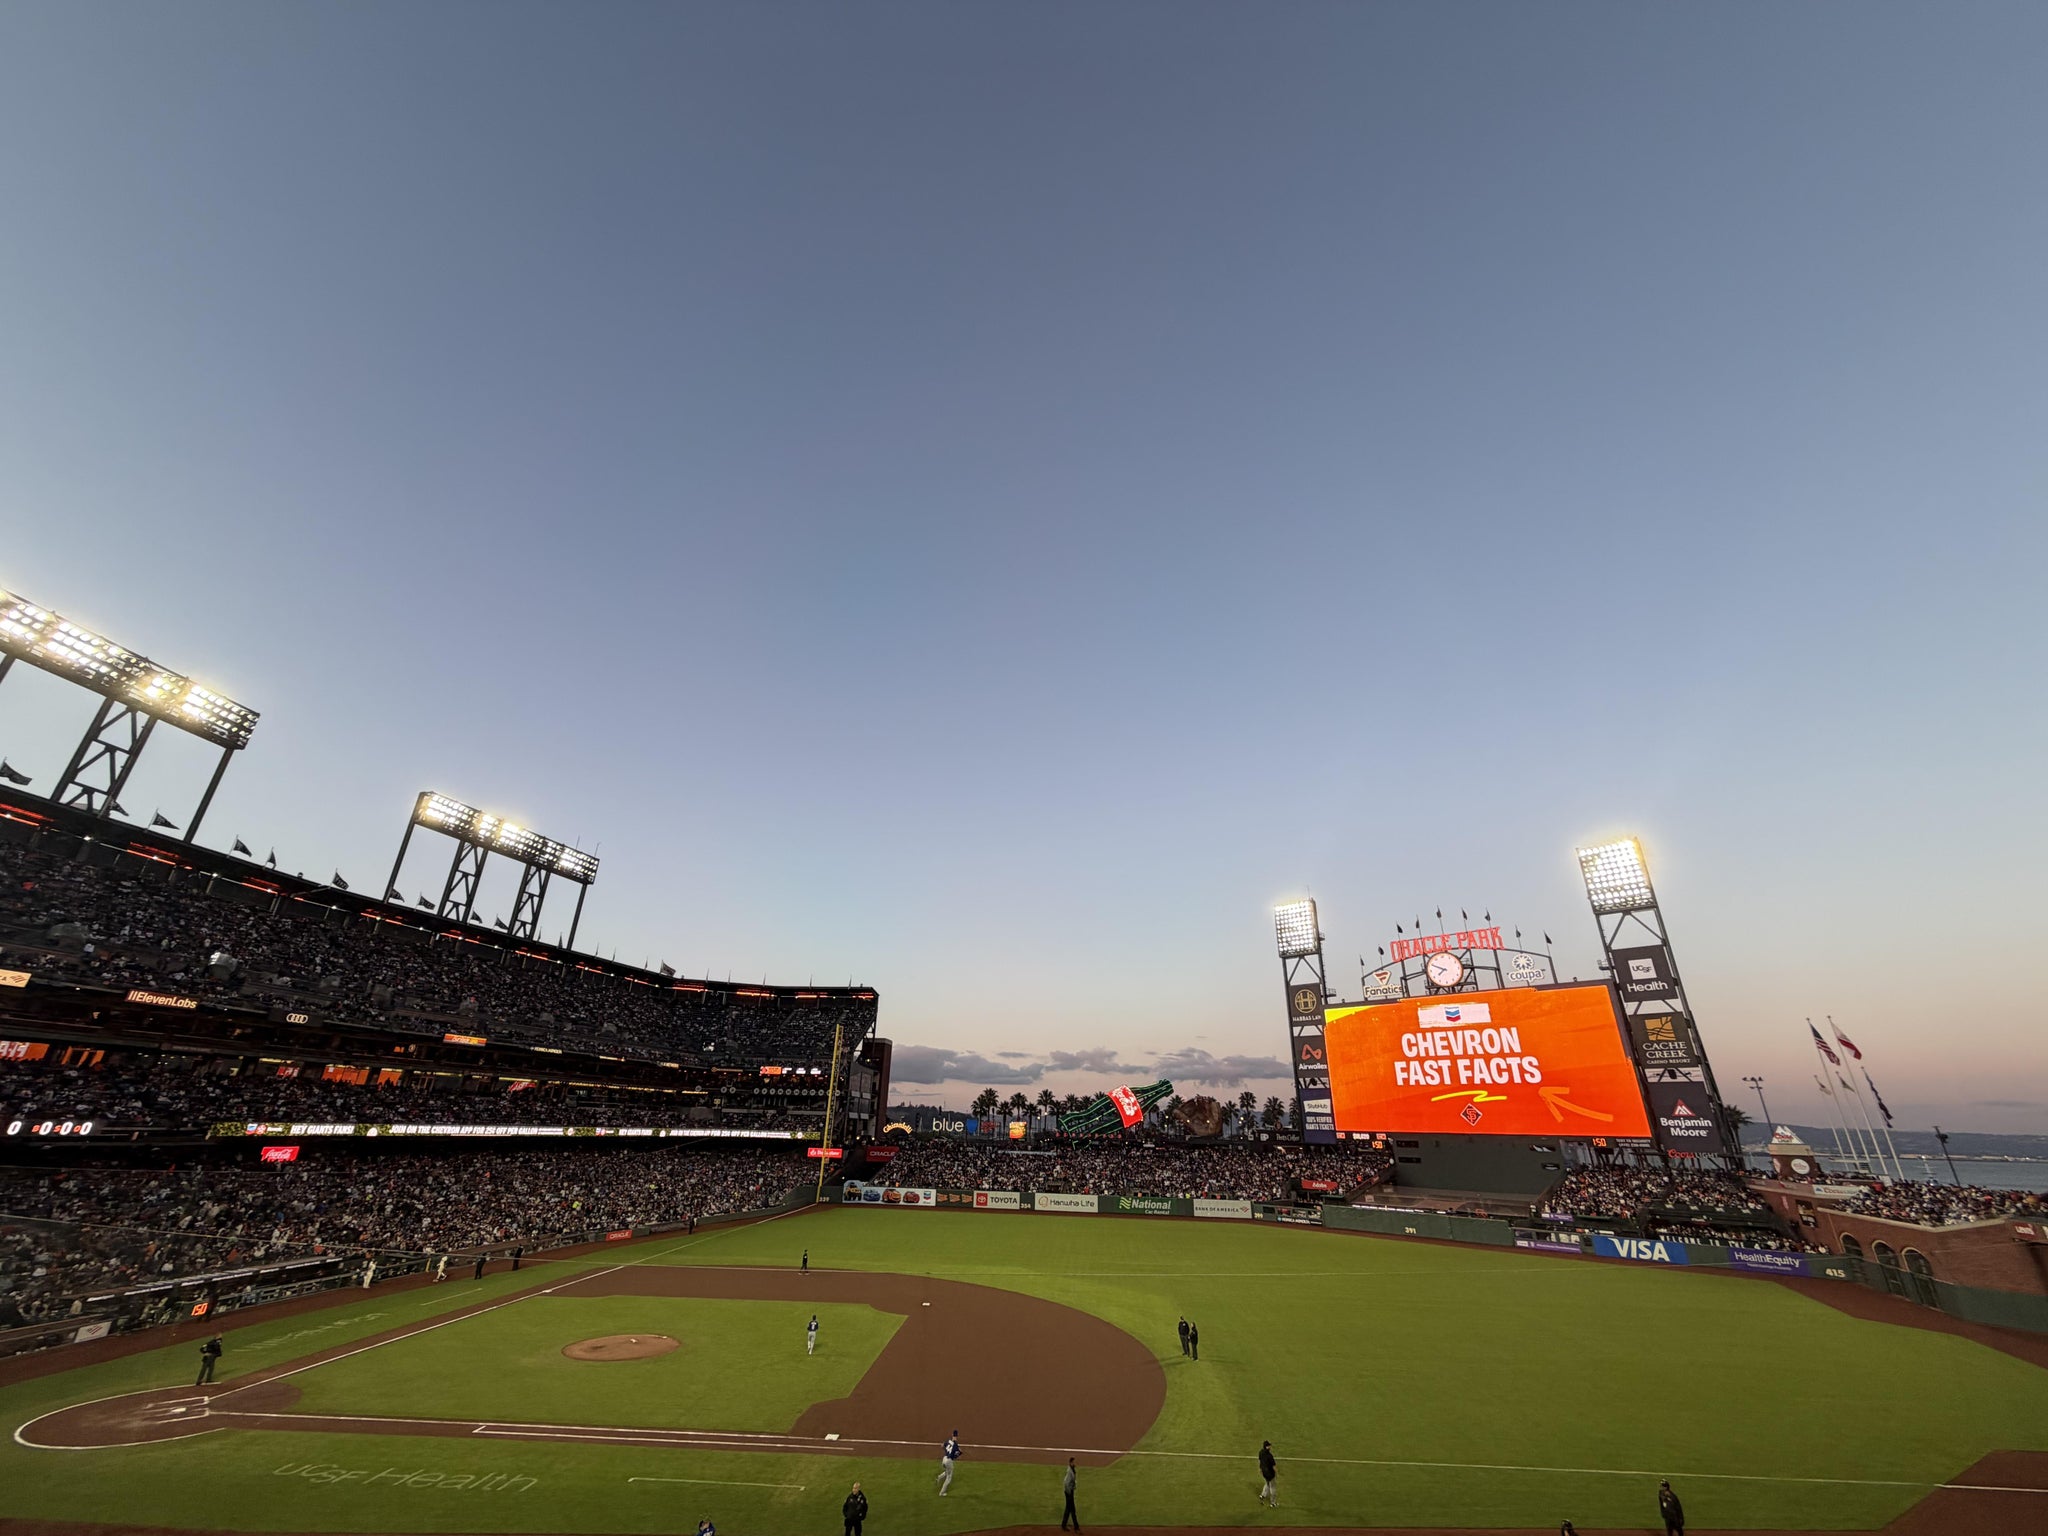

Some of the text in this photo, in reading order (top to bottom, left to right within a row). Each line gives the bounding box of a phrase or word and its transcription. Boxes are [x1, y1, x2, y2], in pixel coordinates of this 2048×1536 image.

[1390, 926, 1505, 962] ORACLE PARK
[1510, 970, 1541, 981] coupa
[1365, 985, 1403, 996] Fanatics
[1627, 981, 1668, 993] Health
[1402, 1027, 1521, 1058] CHEVRON
[1642, 1042, 1687, 1050] CACHE
[1646, 1050, 1687, 1058] CREEK
[1394, 1056, 1542, 1086] FAST FACTS
[932, 1117, 964, 1132] blue
[1660, 1117, 1712, 1129] Benjamin
[1670, 1127, 1708, 1137] Moore
[990, 1196, 1018, 1204] TOYOTA
[1131, 1199, 1171, 1210] National
[1608, 1237, 1670, 1262] VISA
[1734, 1251, 1800, 1268] HealthEquity
[1825, 1268, 1846, 1277] 415
[273, 1463, 538, 1492] UCSF Health
